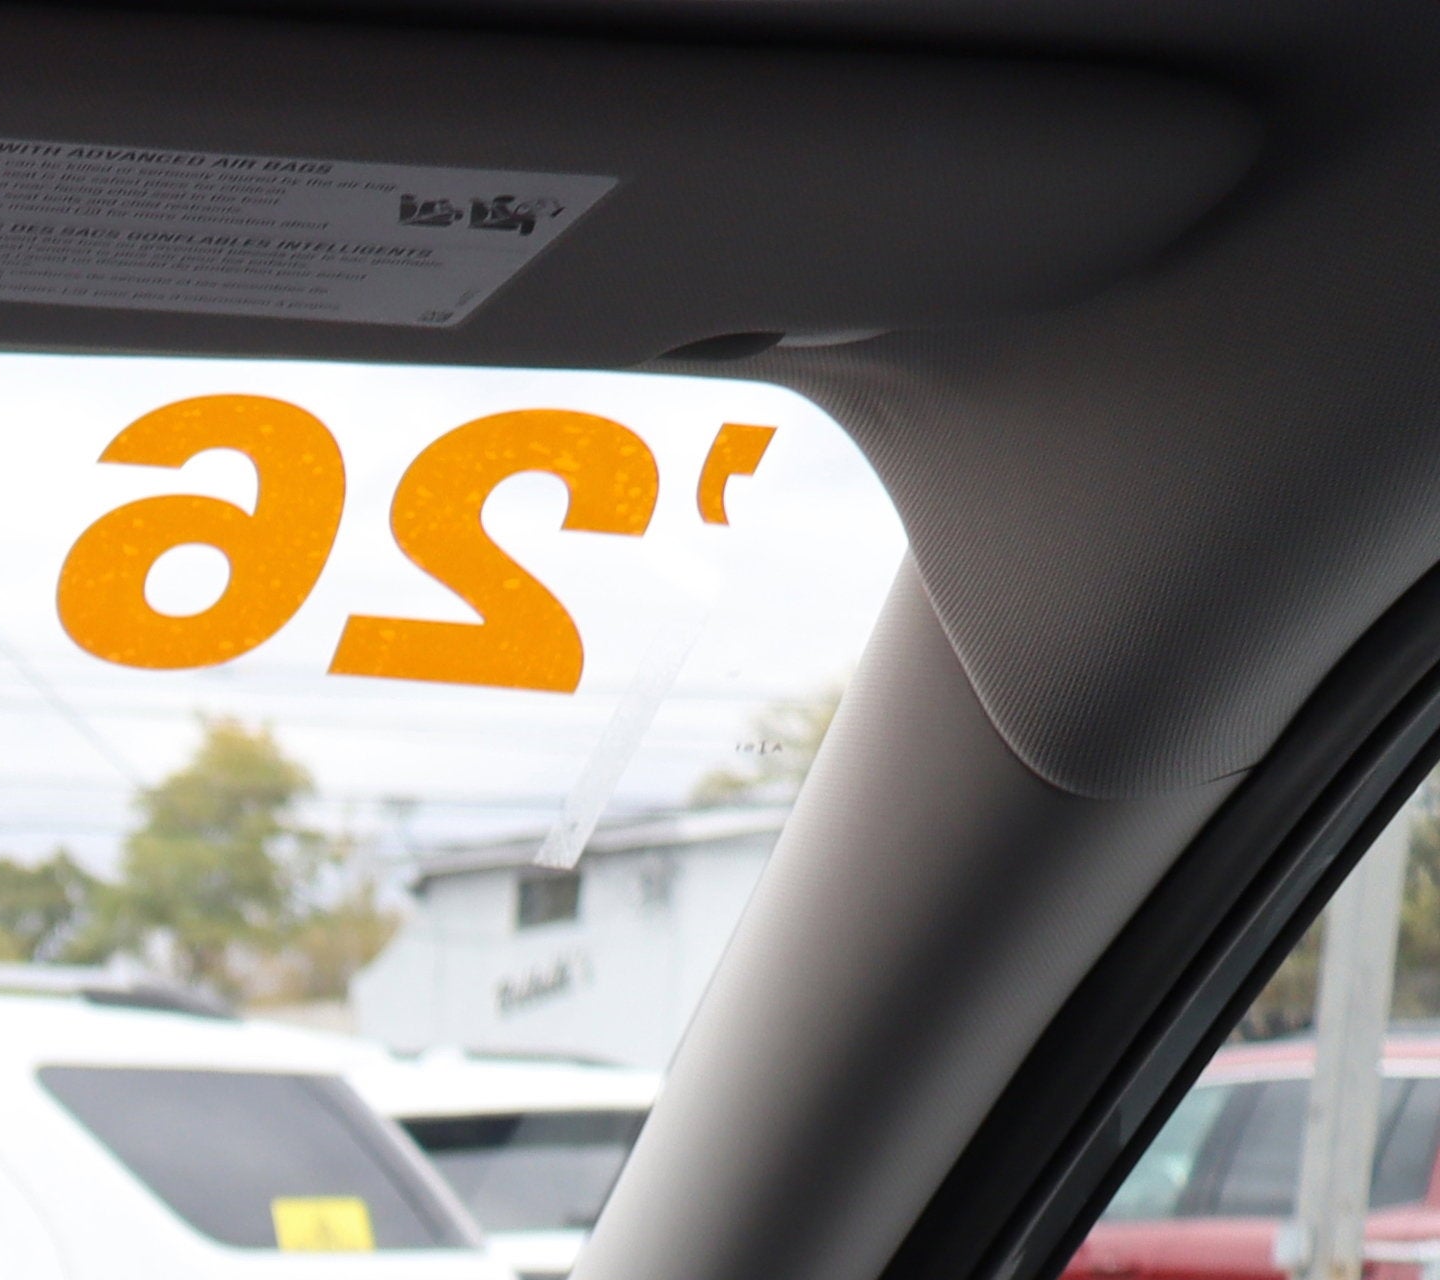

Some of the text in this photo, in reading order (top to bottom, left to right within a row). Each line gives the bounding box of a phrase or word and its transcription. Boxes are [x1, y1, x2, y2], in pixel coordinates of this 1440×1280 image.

[66, 147, 207, 166] ADVANCED
[210, 156, 258, 169] AIR
[261, 160, 334, 174] BAGS
[125, 230, 272, 248] GONFLABLES
[275, 239, 434, 258] INTELLIGENTS
